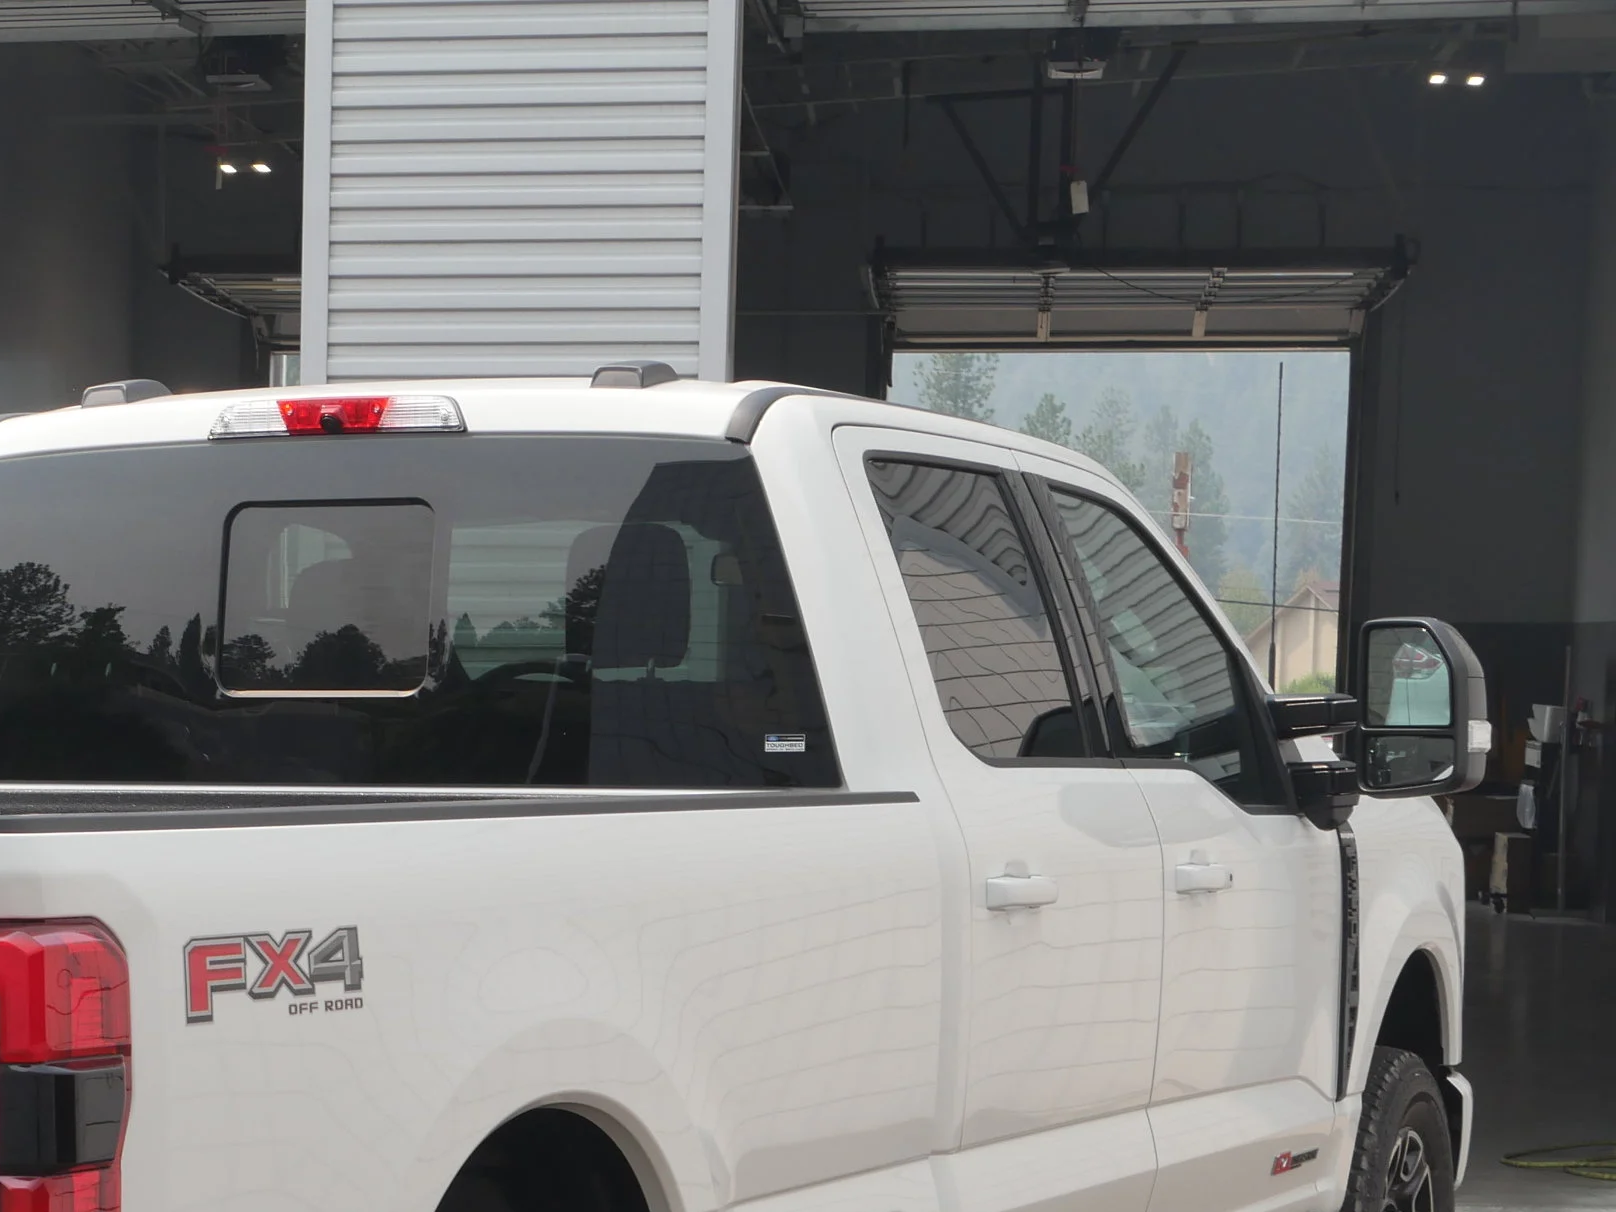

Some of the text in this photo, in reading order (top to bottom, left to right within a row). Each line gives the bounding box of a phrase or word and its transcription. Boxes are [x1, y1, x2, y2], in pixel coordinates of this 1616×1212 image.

[183, 925, 363, 1025] FX4
[288, 997, 364, 1015] OFF ROAD
